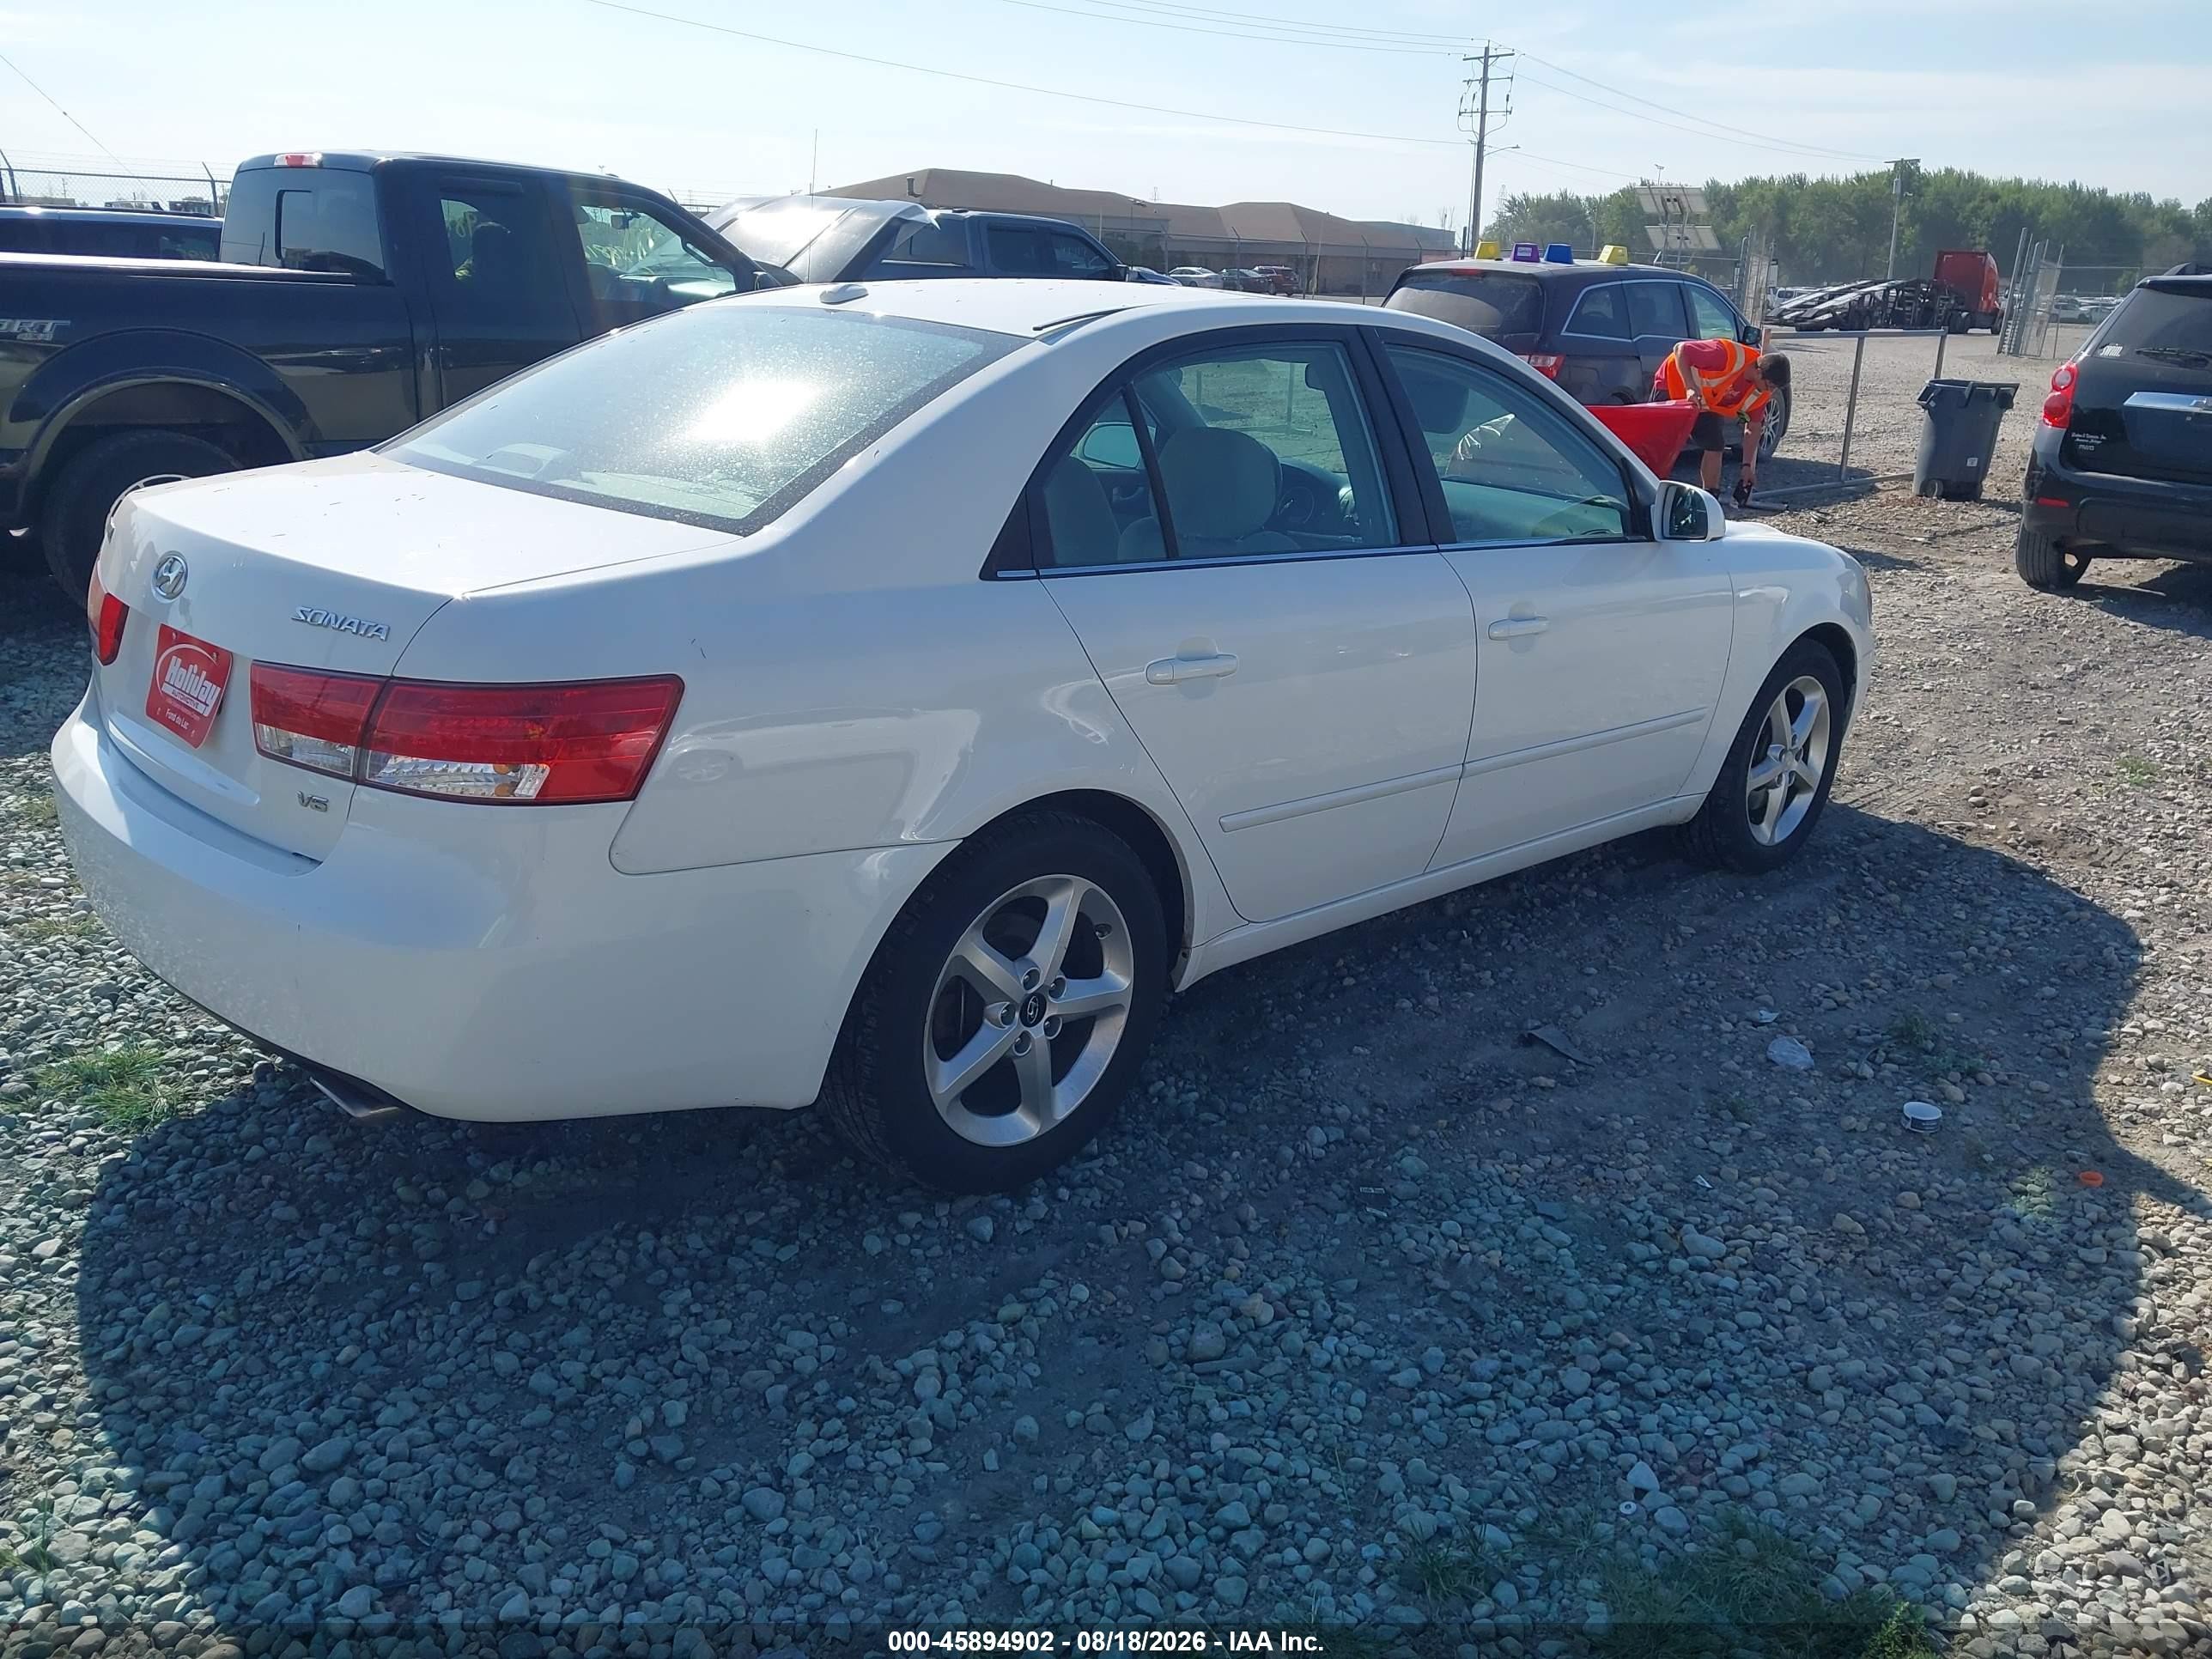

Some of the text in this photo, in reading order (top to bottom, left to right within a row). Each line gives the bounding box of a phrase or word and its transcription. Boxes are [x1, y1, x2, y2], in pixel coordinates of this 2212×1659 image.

[291, 605, 391, 642] SONATA
[164, 654, 222, 715] Holiday
[172, 688, 200, 709] AUTOMOTIVE
[165, 708, 176, 722] Fond
[180, 716, 191, 730] Lac
[295, 789, 330, 812] V6
